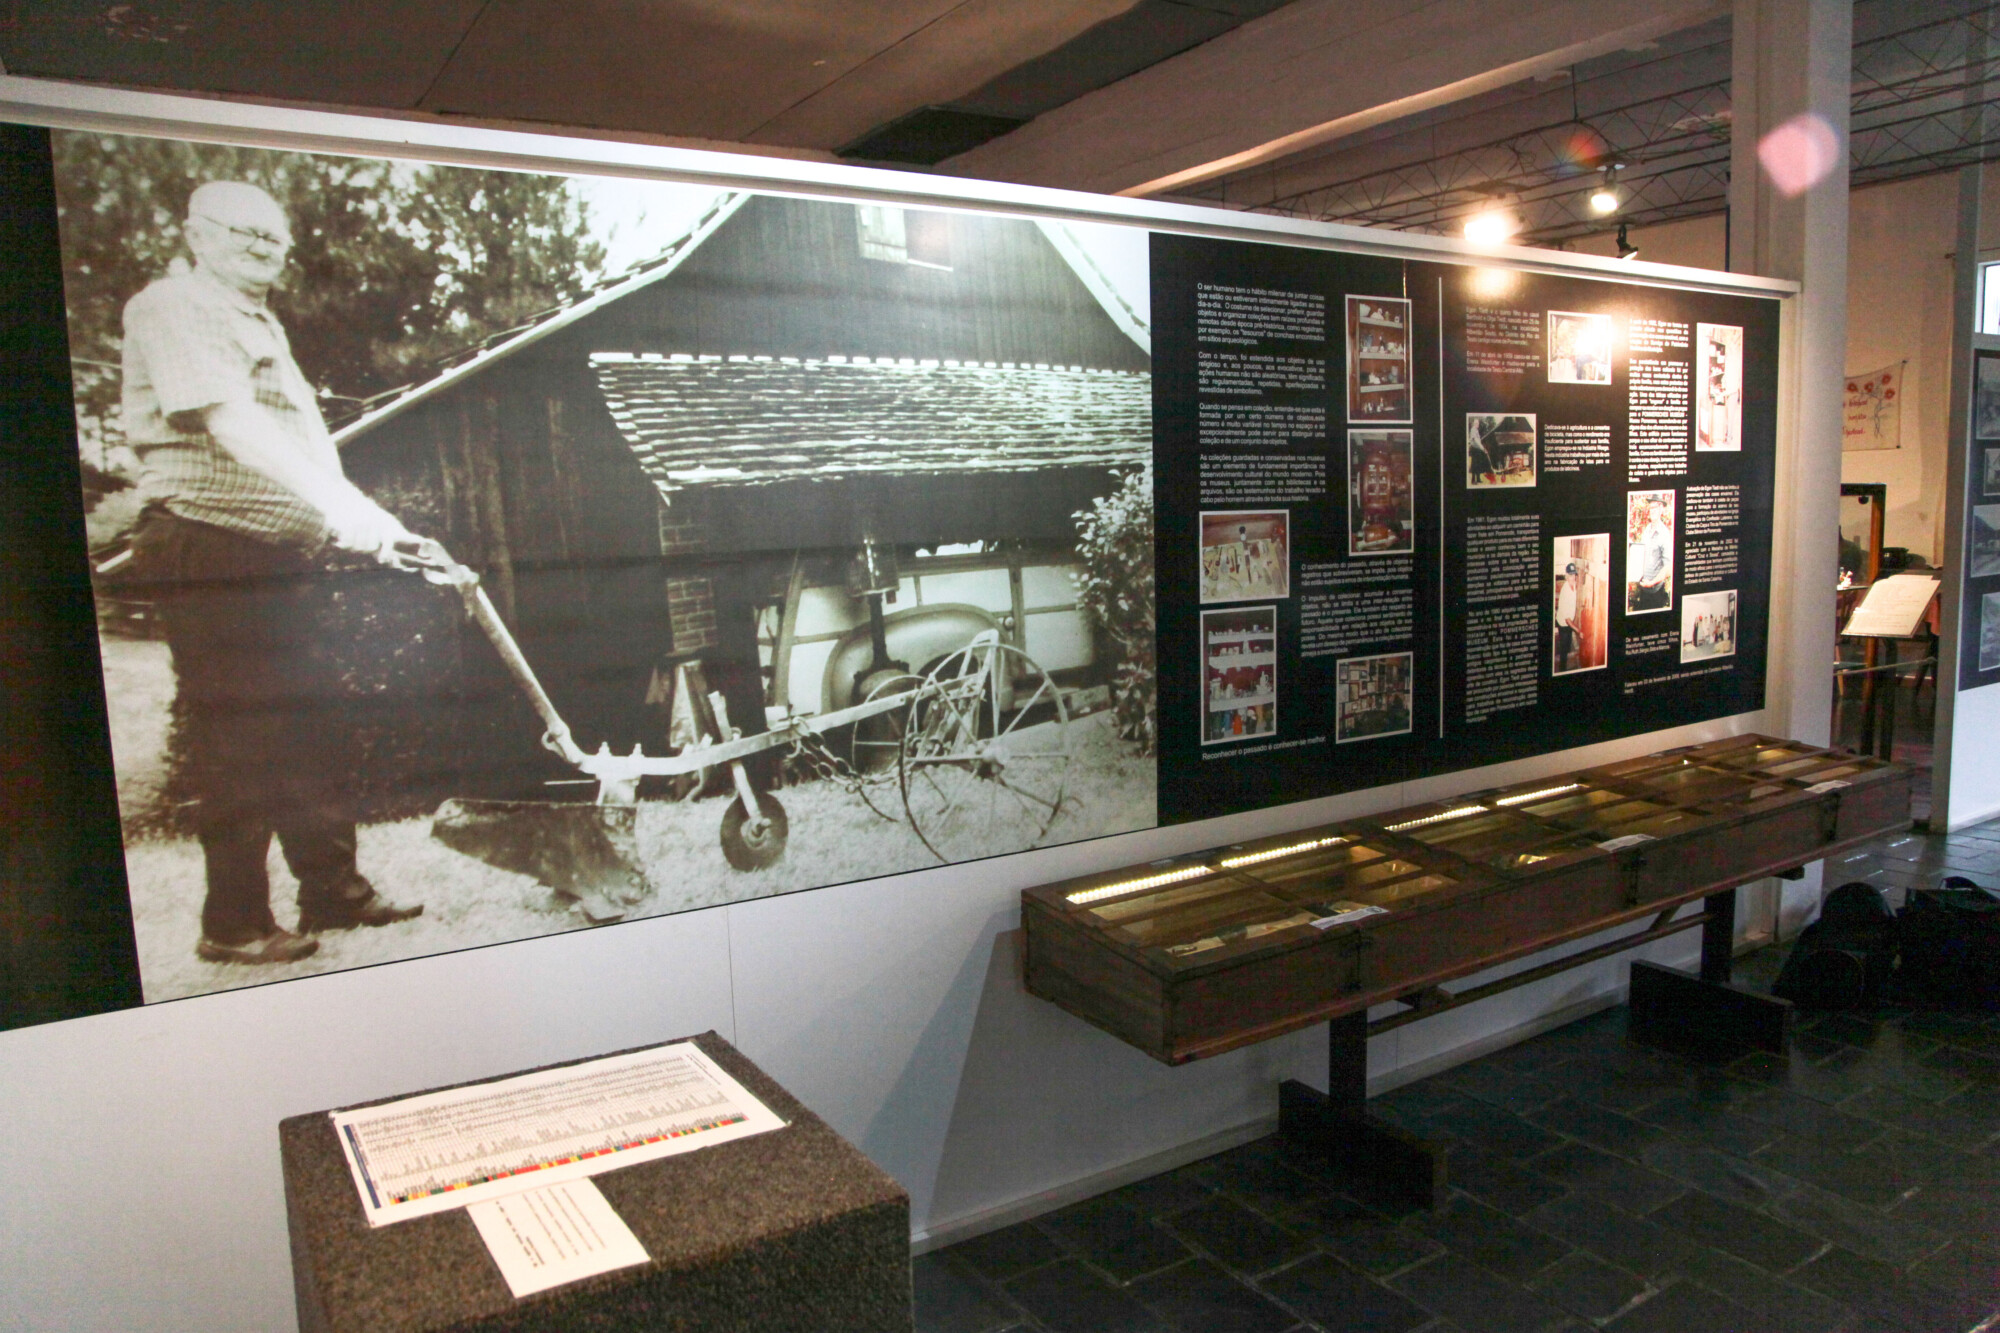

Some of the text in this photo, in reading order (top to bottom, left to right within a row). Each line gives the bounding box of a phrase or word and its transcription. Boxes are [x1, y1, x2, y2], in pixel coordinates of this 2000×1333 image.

[1500, 624, 1538, 634] POMMERSCHES
[1202, 750, 1236, 760] Reconhecer
[1244, 745, 1267, 755] passado
[1274, 740, 1306, 749] conhecer-se
